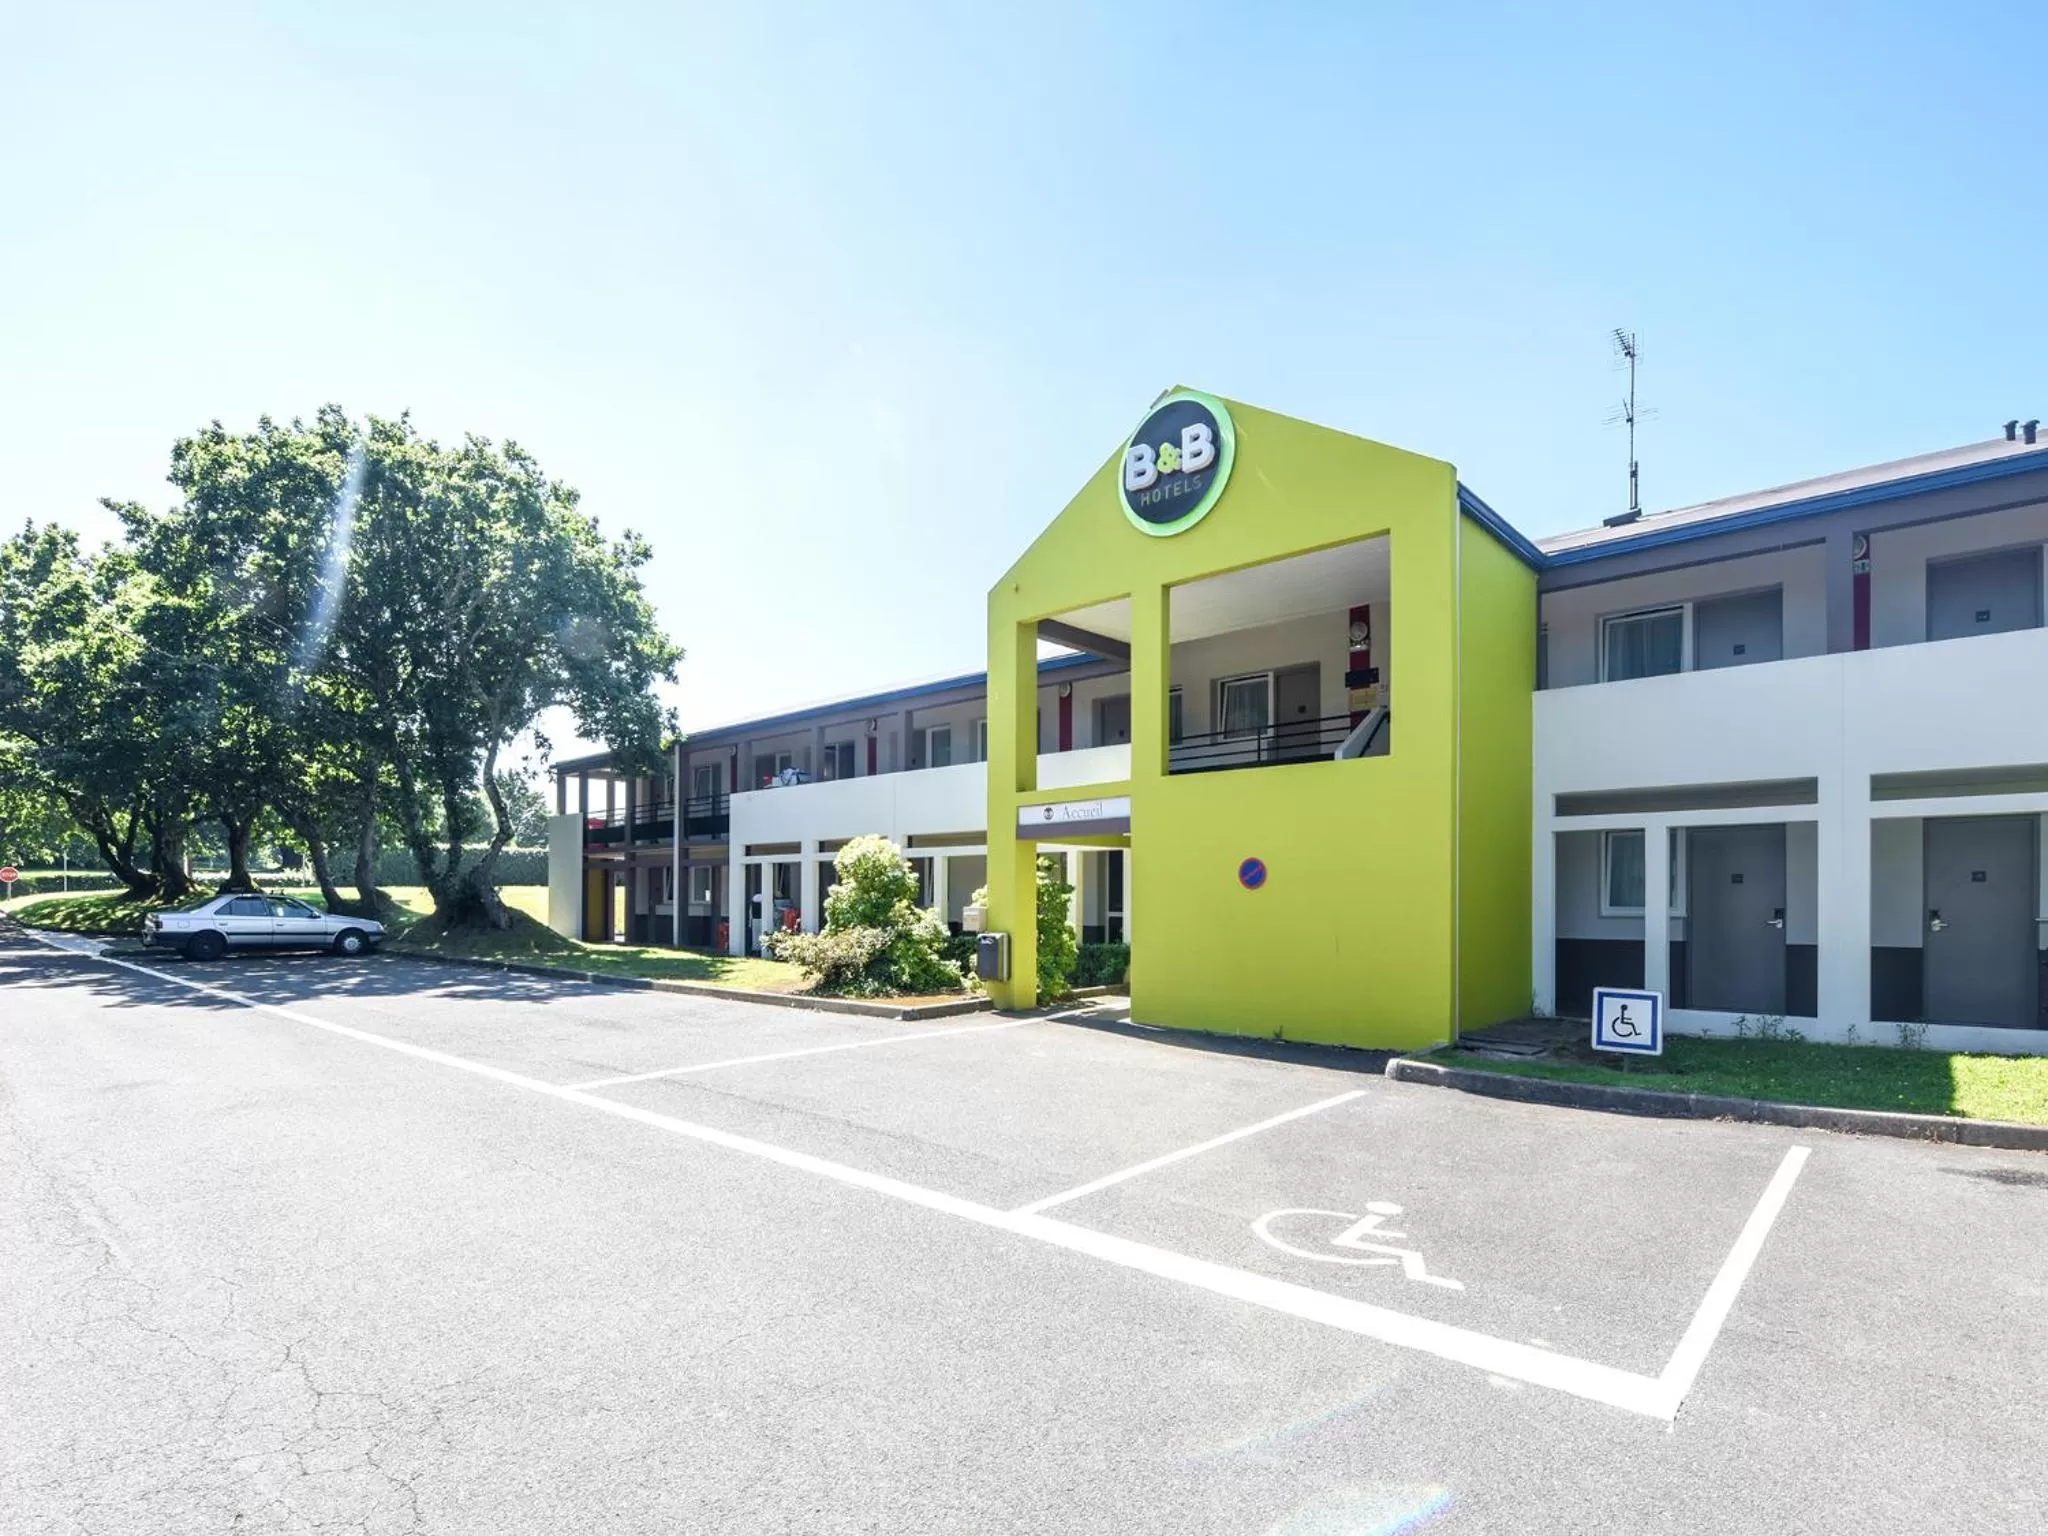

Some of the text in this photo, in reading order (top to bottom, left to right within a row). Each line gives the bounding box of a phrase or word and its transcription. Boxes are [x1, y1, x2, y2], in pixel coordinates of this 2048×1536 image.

[1125, 422, 1216, 492] B&B
[1139, 475, 1203, 507] HOTELS
[1062, 802, 1103, 820] Accueil
